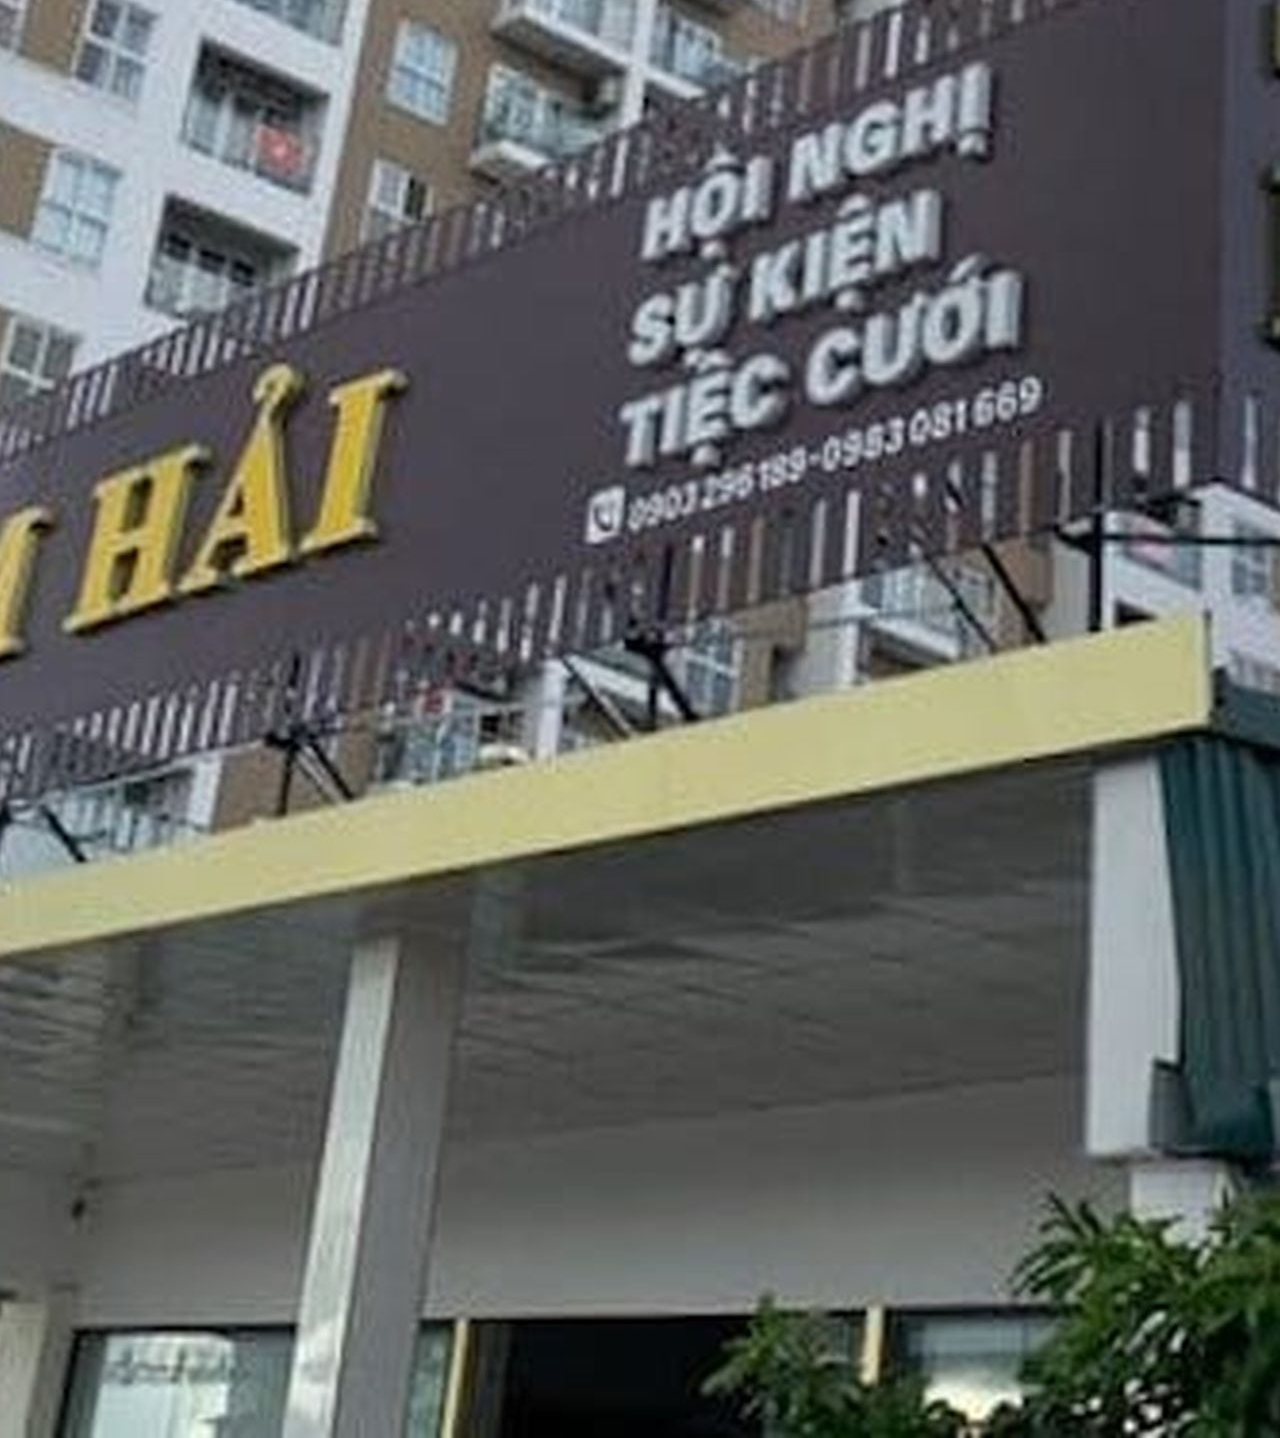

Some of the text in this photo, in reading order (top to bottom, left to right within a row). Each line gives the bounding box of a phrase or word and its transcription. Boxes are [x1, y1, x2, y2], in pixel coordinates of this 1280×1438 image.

[642, 64, 992, 260] HỘI NGHỊ
[748, 189, 943, 322] KIỆN
[620, 254, 1023, 466] TIỆC CƯỚI
[61, 362, 408, 635] HẢI
